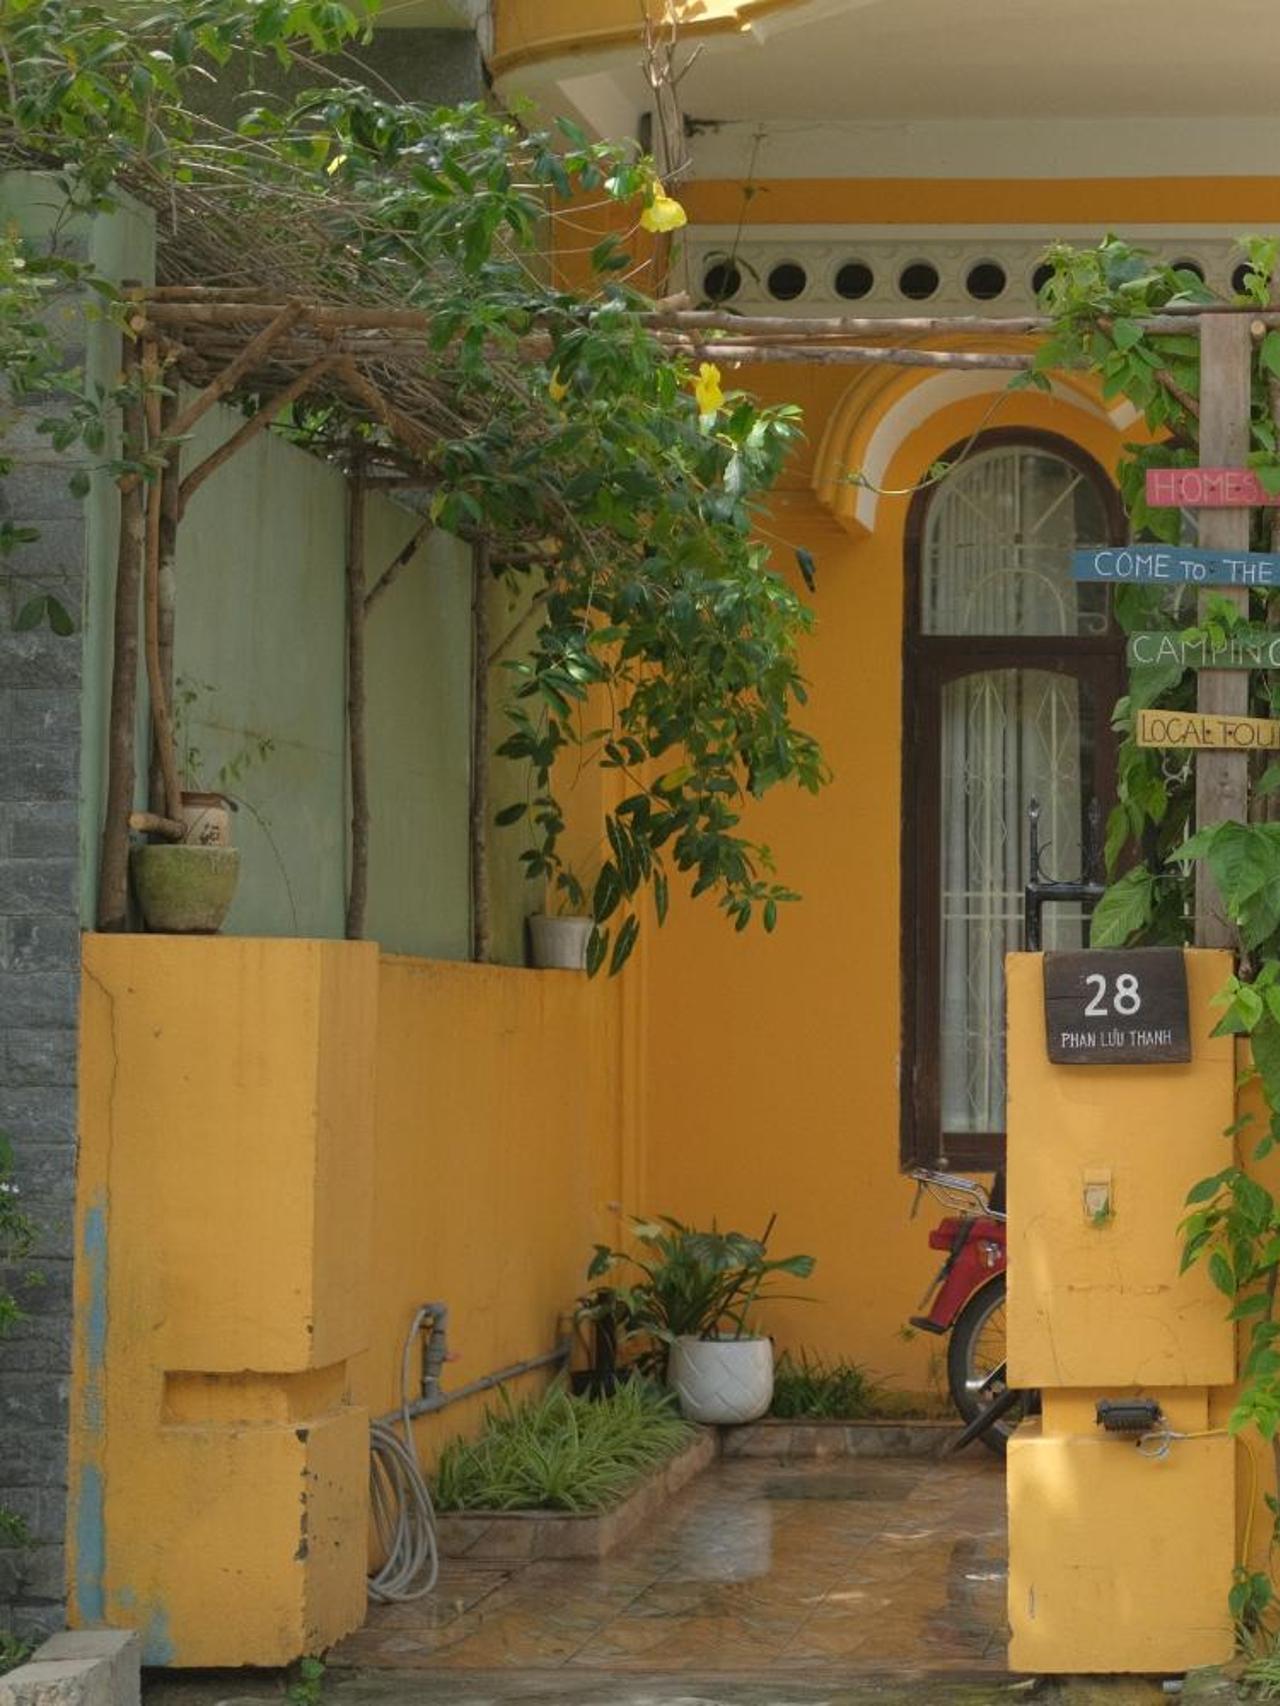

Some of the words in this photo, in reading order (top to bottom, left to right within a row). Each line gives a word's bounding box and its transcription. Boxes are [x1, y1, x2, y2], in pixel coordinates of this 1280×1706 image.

[1095, 551, 1171, 578] COME
[1223, 559, 1274, 584] THE
[1142, 714, 1215, 745] LOCAL
[1084, 973, 1141, 1016] 28
[1061, 1032, 1096, 1048] PHAN
[1129, 1029, 1172, 1046] THANH
